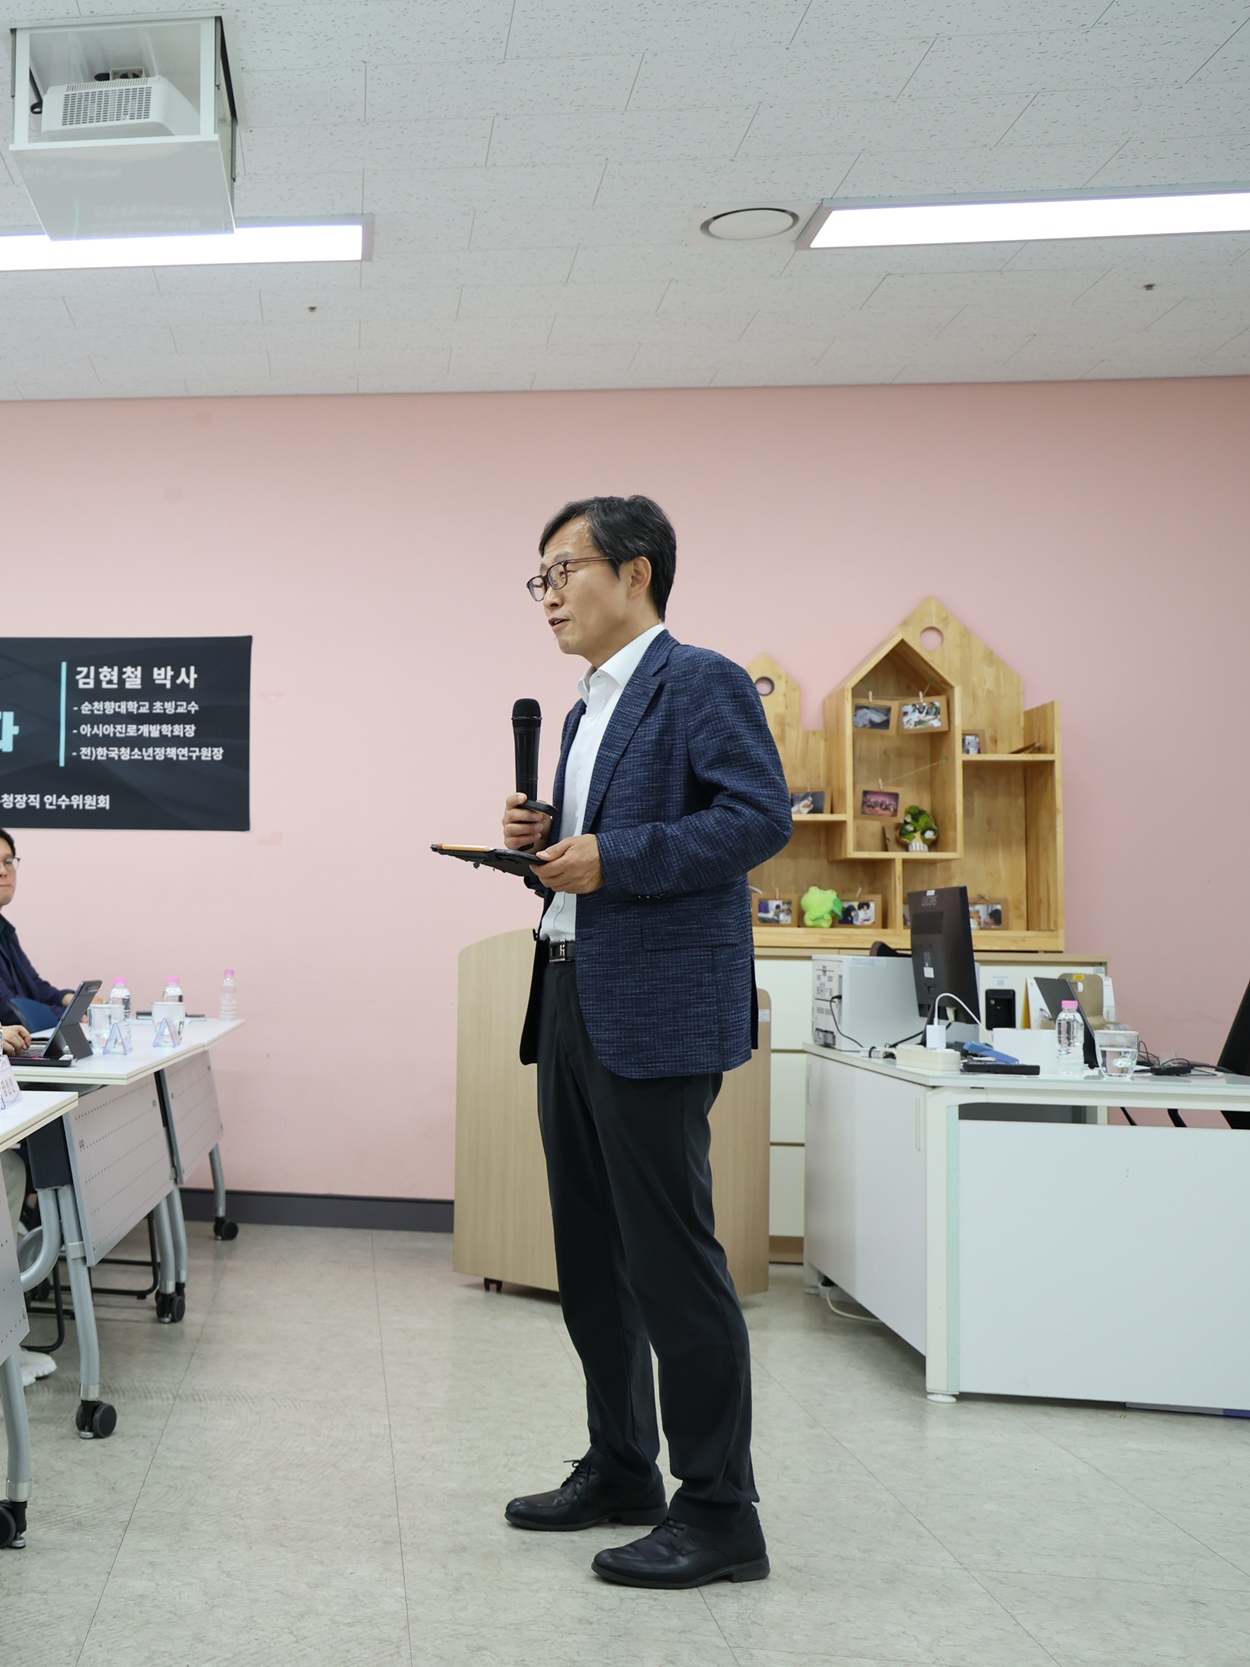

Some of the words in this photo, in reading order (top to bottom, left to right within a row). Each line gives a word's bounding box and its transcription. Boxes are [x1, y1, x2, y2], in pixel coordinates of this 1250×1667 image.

[75, 666, 142, 689] 김현철
[153, 666, 198, 689] 박사
[80, 701, 150, 714] 순천향대학교
[152, 701, 199, 714] 초빙교수
[79, 724, 196, 737] 아시아진로개발학회장
[79, 747, 224, 761] 전)한국청소년정책연구원장
[43, 794, 111, 810] 인수위원회
